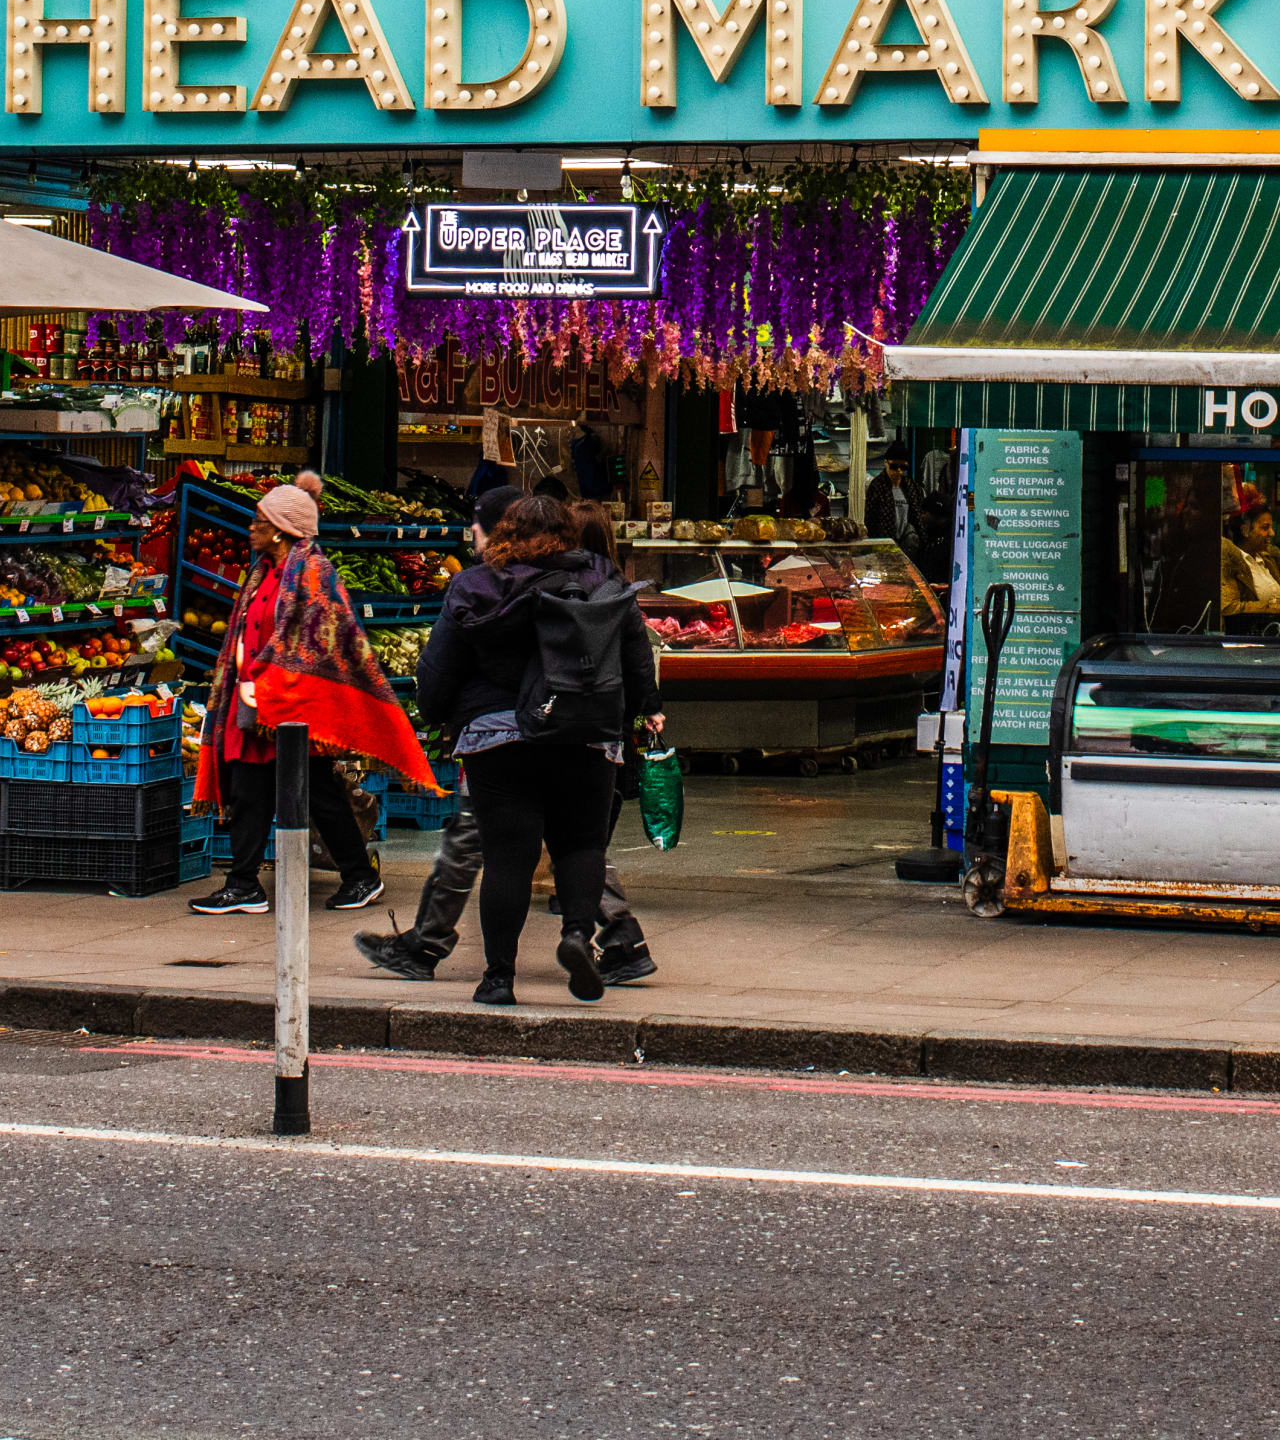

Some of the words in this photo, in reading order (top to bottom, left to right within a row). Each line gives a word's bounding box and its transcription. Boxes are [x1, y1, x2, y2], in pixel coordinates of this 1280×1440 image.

[439, 224, 526, 251] UPPER
[534, 227, 623, 252] PLACE
[523, 253, 535, 267] AT
[566, 253, 589, 267] HEAD
[591, 253, 629, 268] MARKET
[465, 282, 497, 293] MORE
[499, 283, 529, 294] FOOD
[531, 283, 554, 294] AND
[555, 283, 594, 295] DRINKS
[1004, 446, 1040, 454] FABRIC
[1042, 446, 1050, 454] &
[1005, 456, 1049, 465] CLOTHES
[989, 477, 1016, 486] SHOE
[1018, 477, 1054, 486] REPAIR
[1056, 477, 1065, 486] &
[995, 487, 1015, 496] KEY
[1017, 488, 1058, 496] CUTTING
[983, 508, 1017, 517] TAILOR
[1020, 509, 1028, 517] &
[1030, 509, 1070, 518] SEWING
[996, 519, 1060, 528] CCESSORIES
[984, 540, 1021, 549] TRAVEL
[1022, 540, 1069, 549] LUGGAGE
[991, 551, 1000, 559] &
[1001, 551, 1029, 559] COOK
[1031, 551, 1061, 560] WEAR
[1002, 572, 1049, 581] SMOKING
[1056, 583, 1065, 591] &
[1016, 615, 1063, 624] BALOONS
[1065, 616, 1074, 624] &
[1033, 626, 1068, 634] CARDS
[1027, 647, 1062, 655] PHONE
[1009, 657, 1018, 665] &
[1031, 689, 1039, 697] &
[991, 719, 1026, 728] WATCH
